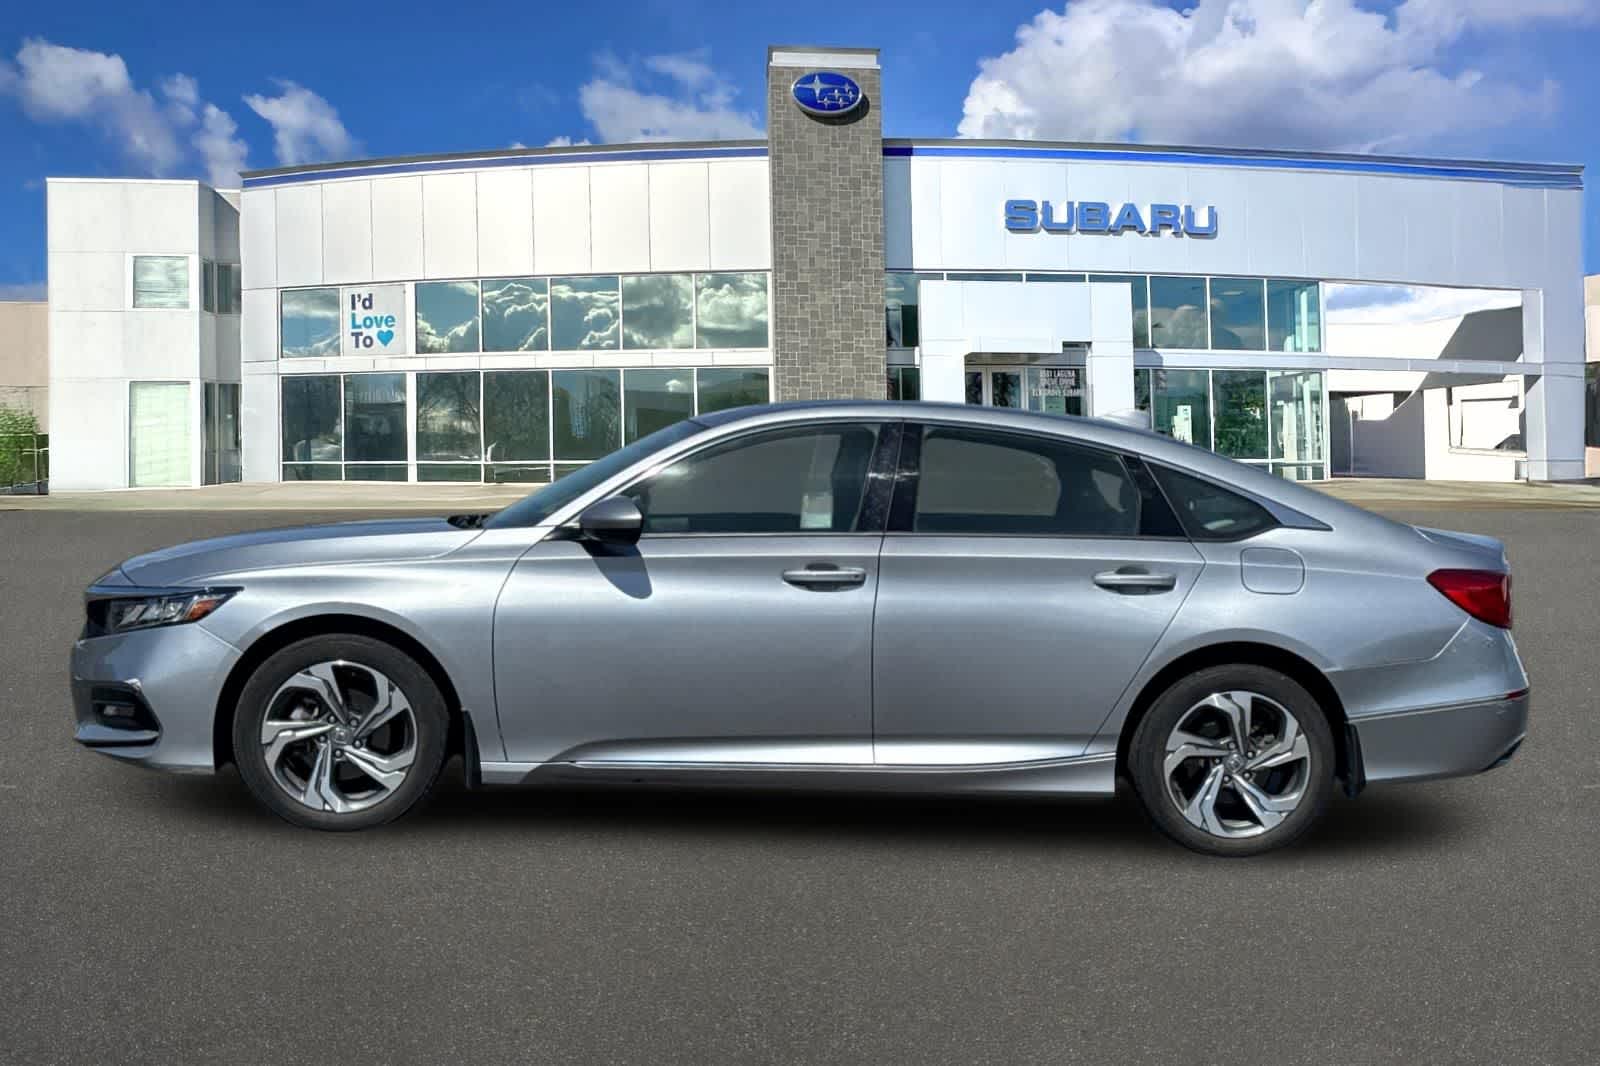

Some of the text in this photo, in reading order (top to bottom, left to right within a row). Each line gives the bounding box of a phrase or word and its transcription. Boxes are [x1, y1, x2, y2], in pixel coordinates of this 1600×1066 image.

[1005, 200, 1217, 237] SUBARU
[351, 293, 373, 311] I’d
[351, 312, 396, 329] Love
[351, 332, 374, 348] To
